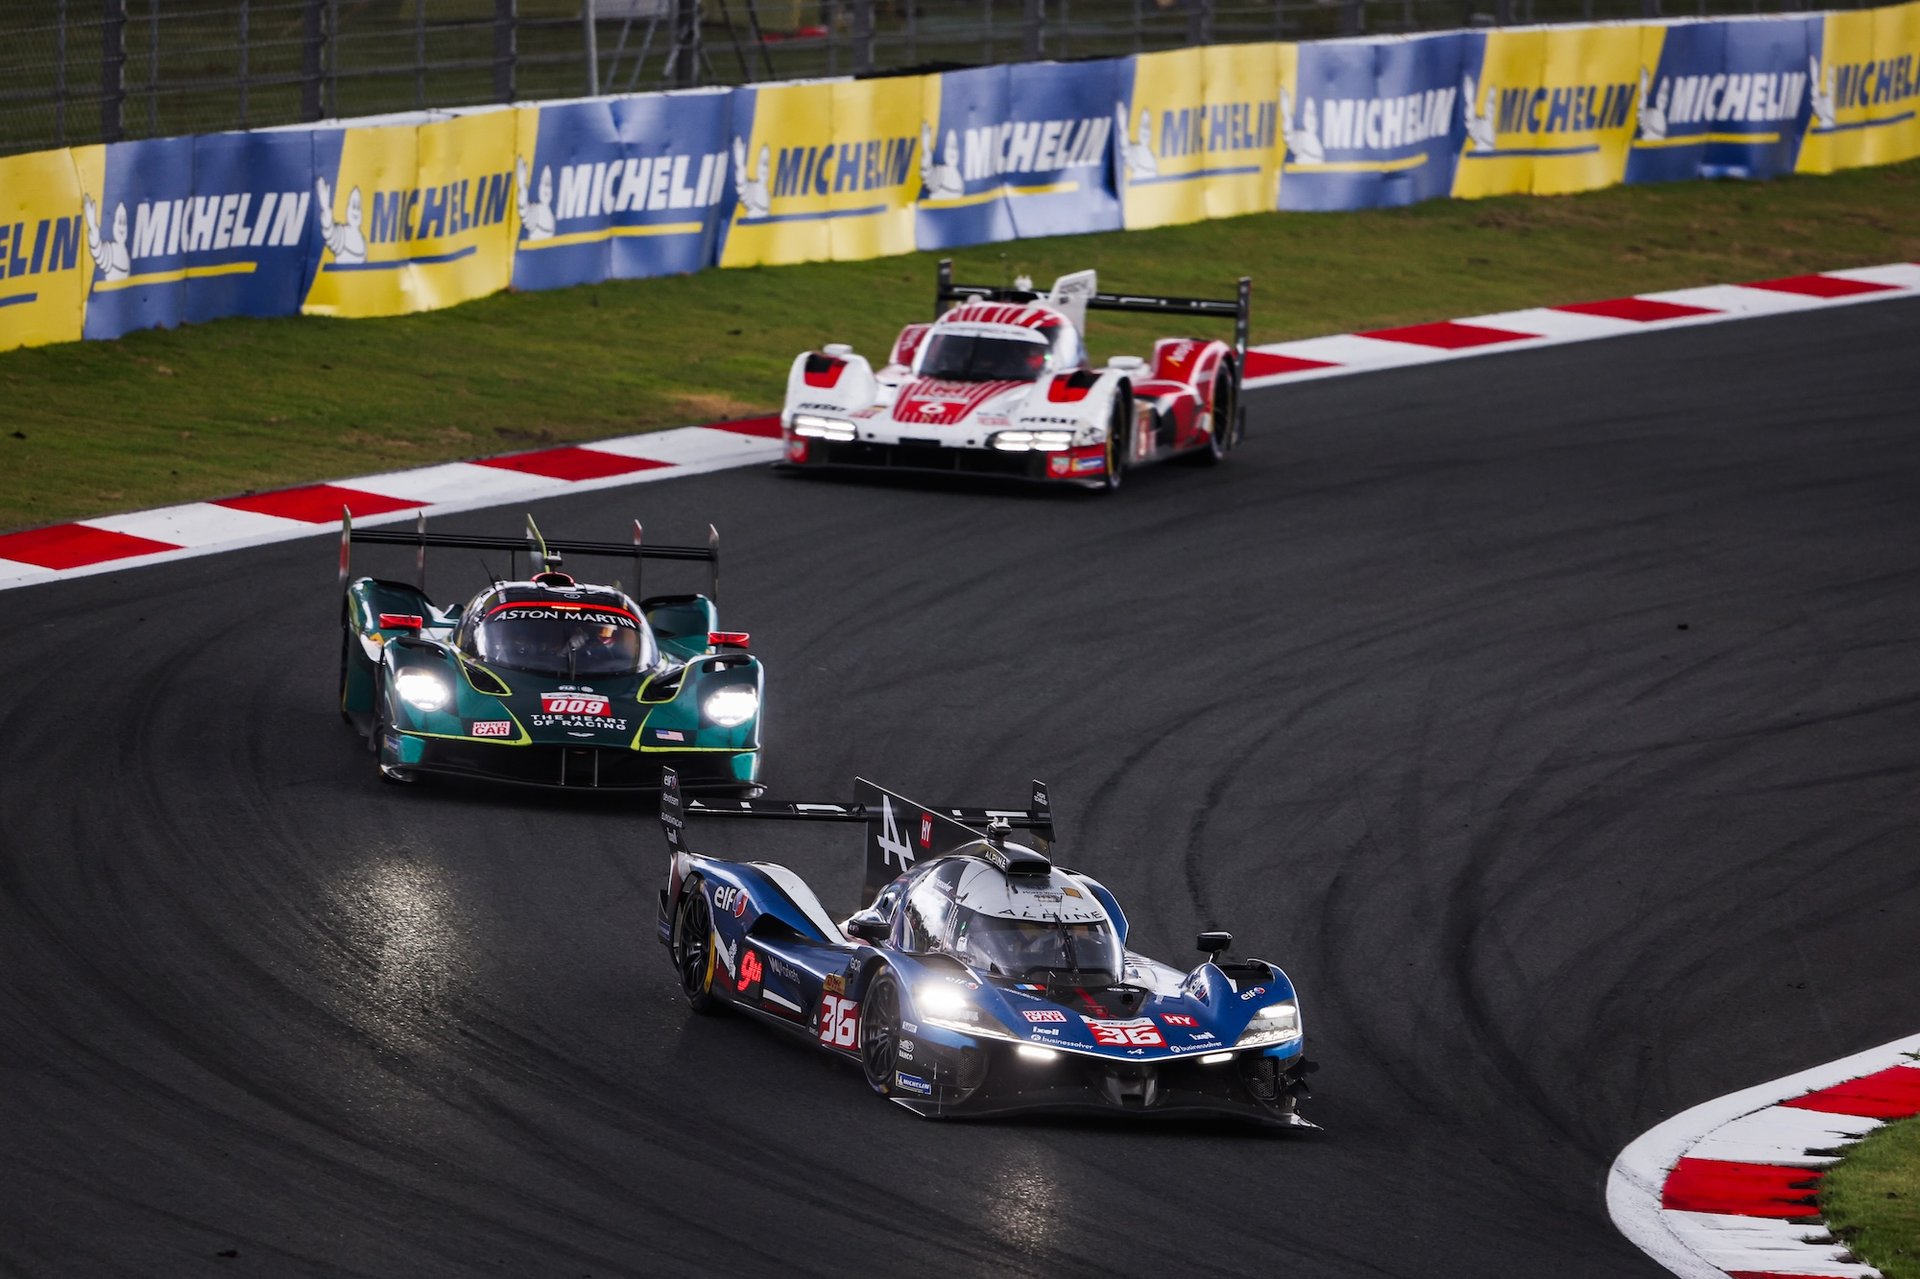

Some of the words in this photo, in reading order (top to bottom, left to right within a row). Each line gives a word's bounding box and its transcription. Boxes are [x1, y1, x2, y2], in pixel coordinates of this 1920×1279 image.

[1668, 72, 1807, 123] MICHELIN
[1323, 86, 1456, 149] MICHELIN
[1497, 84, 1636, 133] MICHELIN
[963, 117, 1111, 180] MICHELIN
[773, 137, 918, 197] MICHELIN
[370, 172, 512, 243] MICHELIN
[132, 191, 311, 259] MICHELIN
[918, 402, 946, 415] 6
[494, 610, 558, 621] ASTON
[565, 611, 636, 629] MARTIN
[549, 700, 604, 714] 009
[562, 720, 627, 731] RACING
[571, 715, 627, 725] HEART
[475, 726, 507, 735] CAR
[985, 850, 1008, 869] ALPINE
[714, 885, 735, 911] elf
[998, 908, 1103, 920] ALPINE
[1240, 989, 1258, 1001] elf
[820, 994, 858, 1047] 36
[1028, 1014, 1064, 1022] CAR
[1164, 1014, 1192, 1025] HY
[1041, 1036, 1095, 1050] businessolver
[1091, 1025, 1163, 1045] 36
[903, 1078, 931, 1090] MICHELIN
